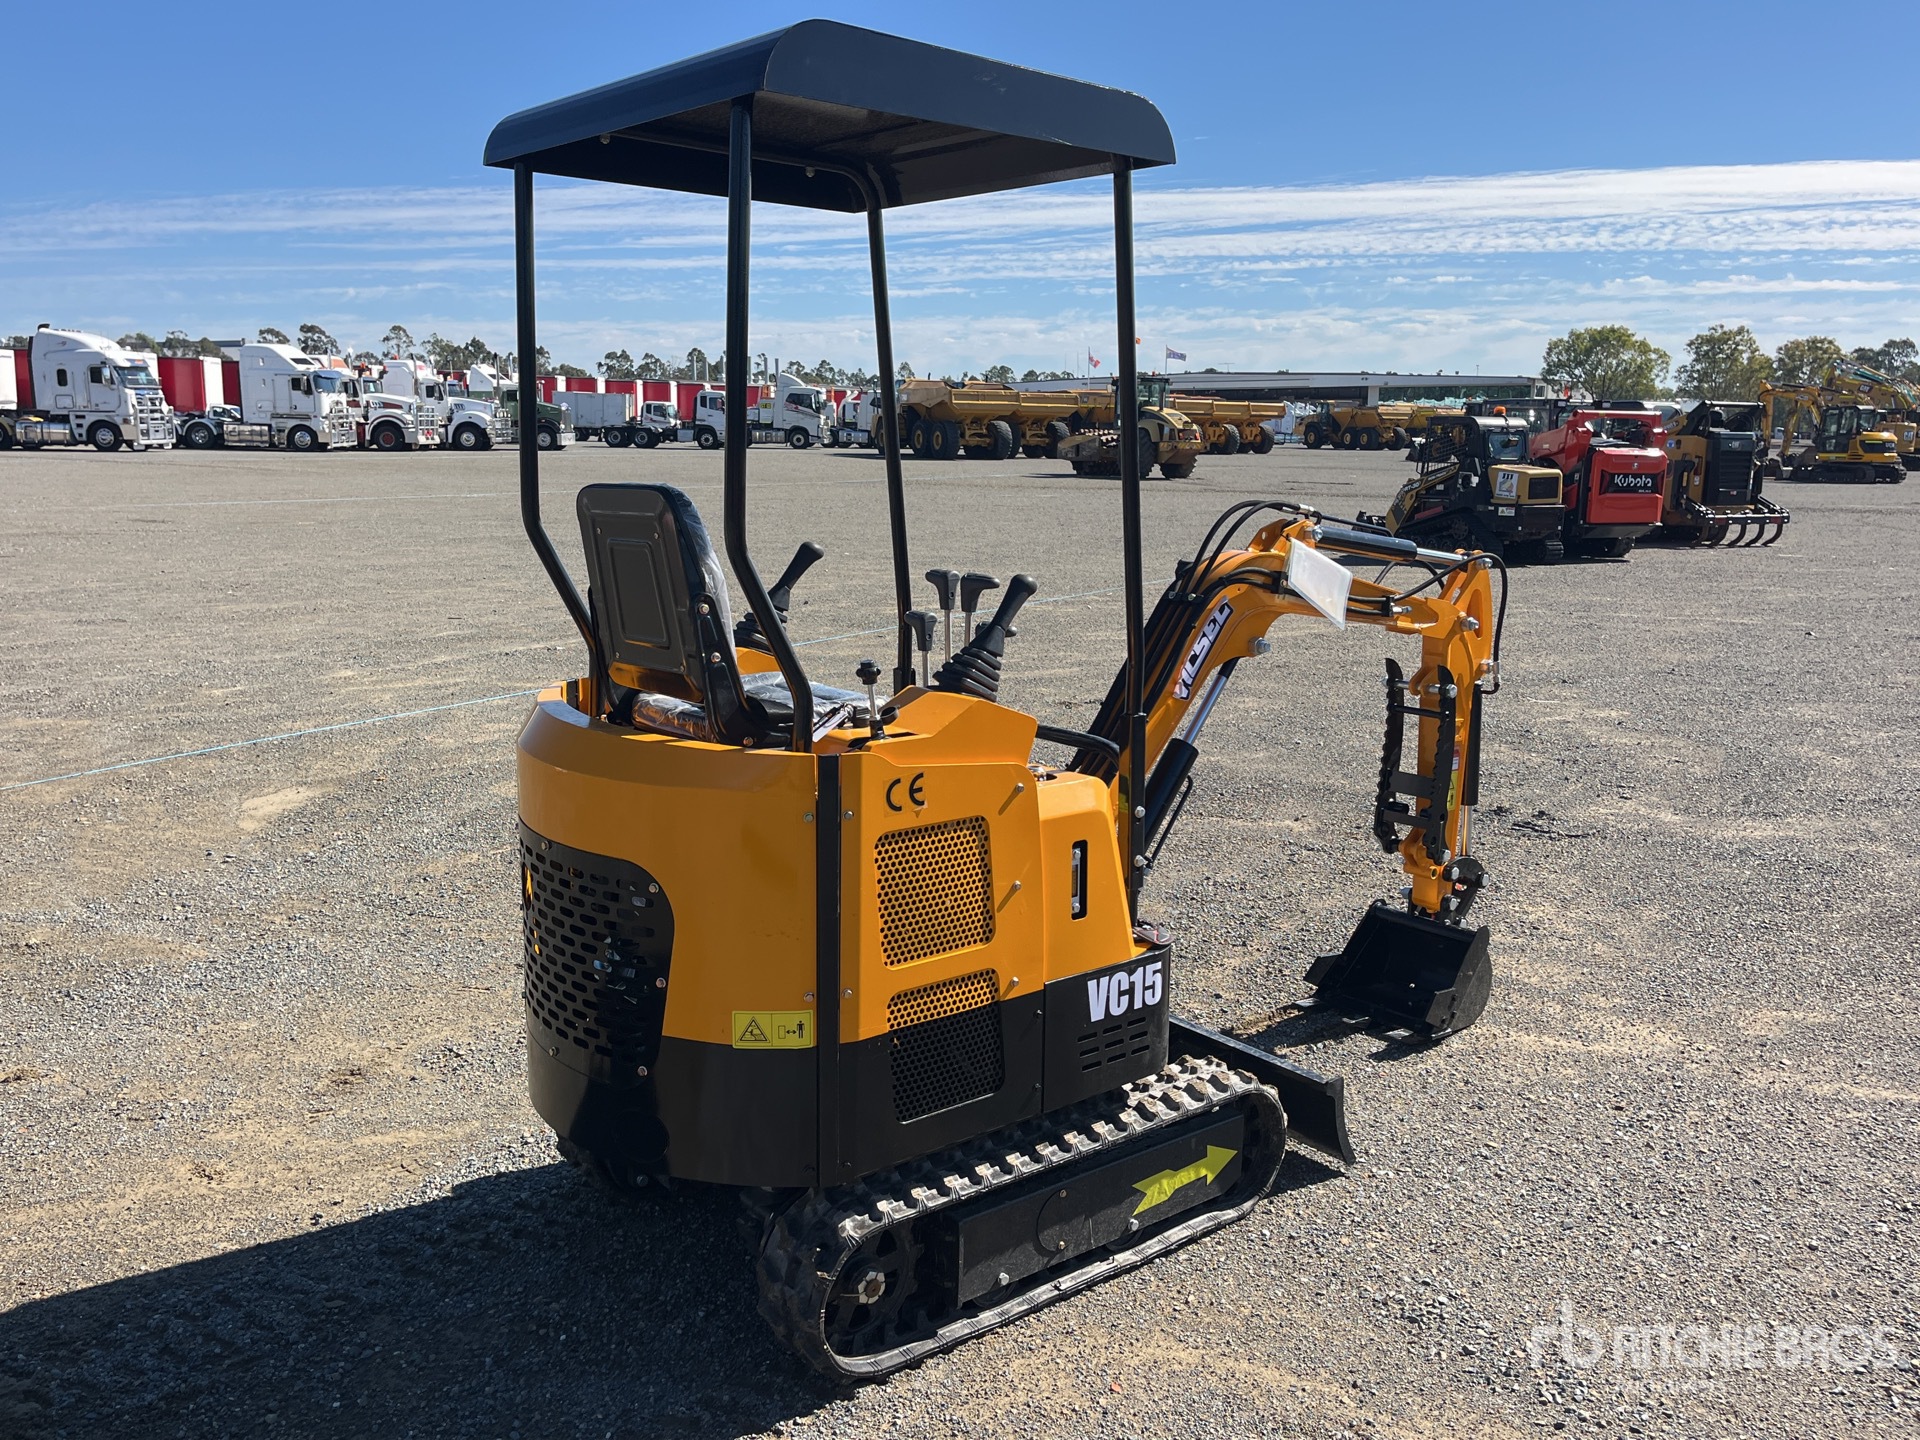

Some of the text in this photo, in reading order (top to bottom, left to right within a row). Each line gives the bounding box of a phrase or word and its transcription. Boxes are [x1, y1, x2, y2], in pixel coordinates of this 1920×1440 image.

[1614, 474, 1652, 487] Kubota
[886, 772, 925, 812] CE
[1087, 961, 1163, 1023] VC15
